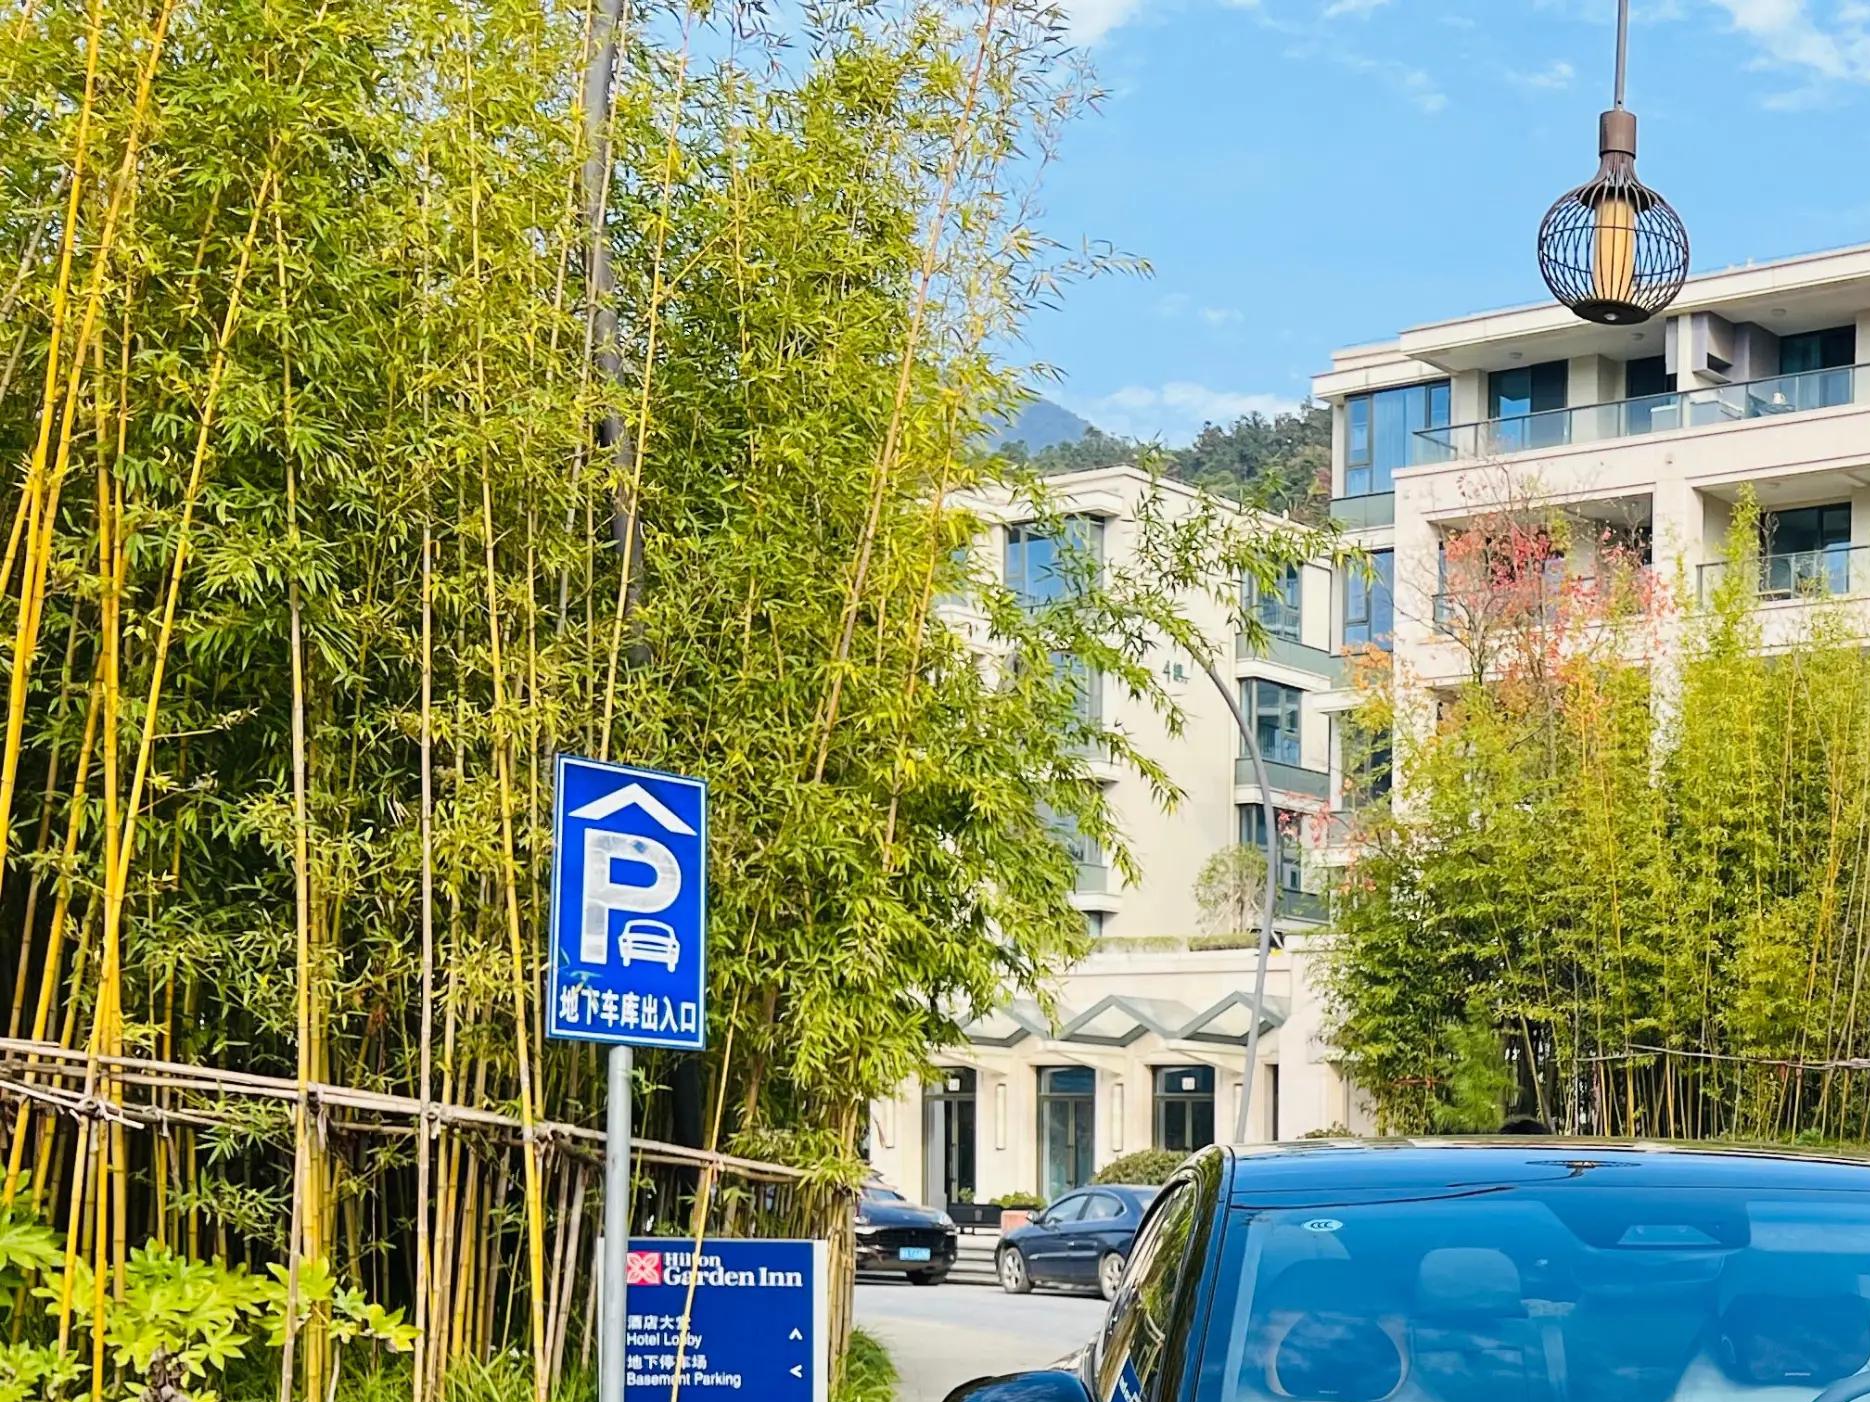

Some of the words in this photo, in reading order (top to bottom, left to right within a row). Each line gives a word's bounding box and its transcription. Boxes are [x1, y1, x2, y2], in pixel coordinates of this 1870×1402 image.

[580, 828, 681, 964] P
[559, 985, 696, 1033] 地下车库出入口
[664, 1252, 720, 1266] Hilon
[664, 1266, 755, 1286] Garden
[760, 1267, 802, 1286] Inn
[626, 1332, 660, 1347] Hotel
[663, 1332, 702, 1349] Loby
[626, 1371, 690, 1386] Basemnt
[694, 1372, 742, 1389] Parking
